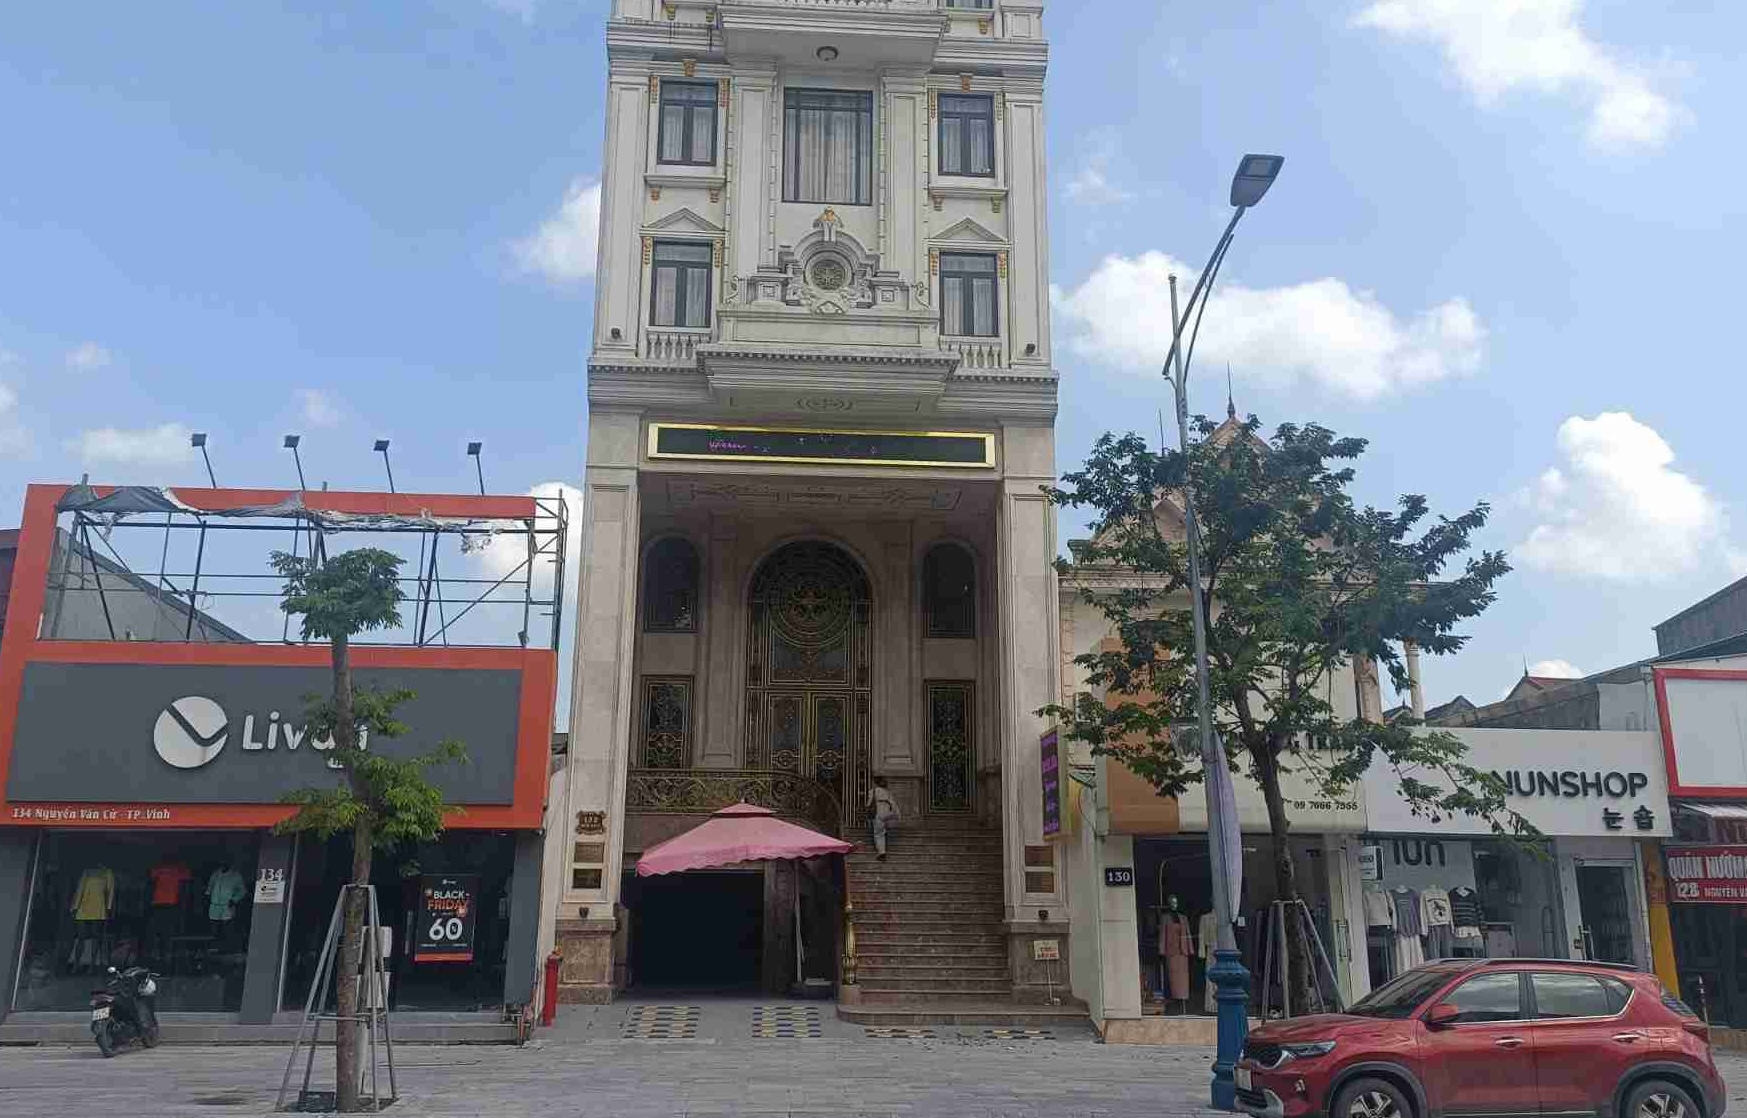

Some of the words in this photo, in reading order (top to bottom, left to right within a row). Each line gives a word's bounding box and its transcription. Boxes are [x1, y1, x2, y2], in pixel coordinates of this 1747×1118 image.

[12, 808, 33, 818] 134
[146, 809, 170, 819] Vinh
[260, 868, 283, 881] 134
[1107, 871, 1131, 882] 130
[433, 890, 466, 899] BLACK
